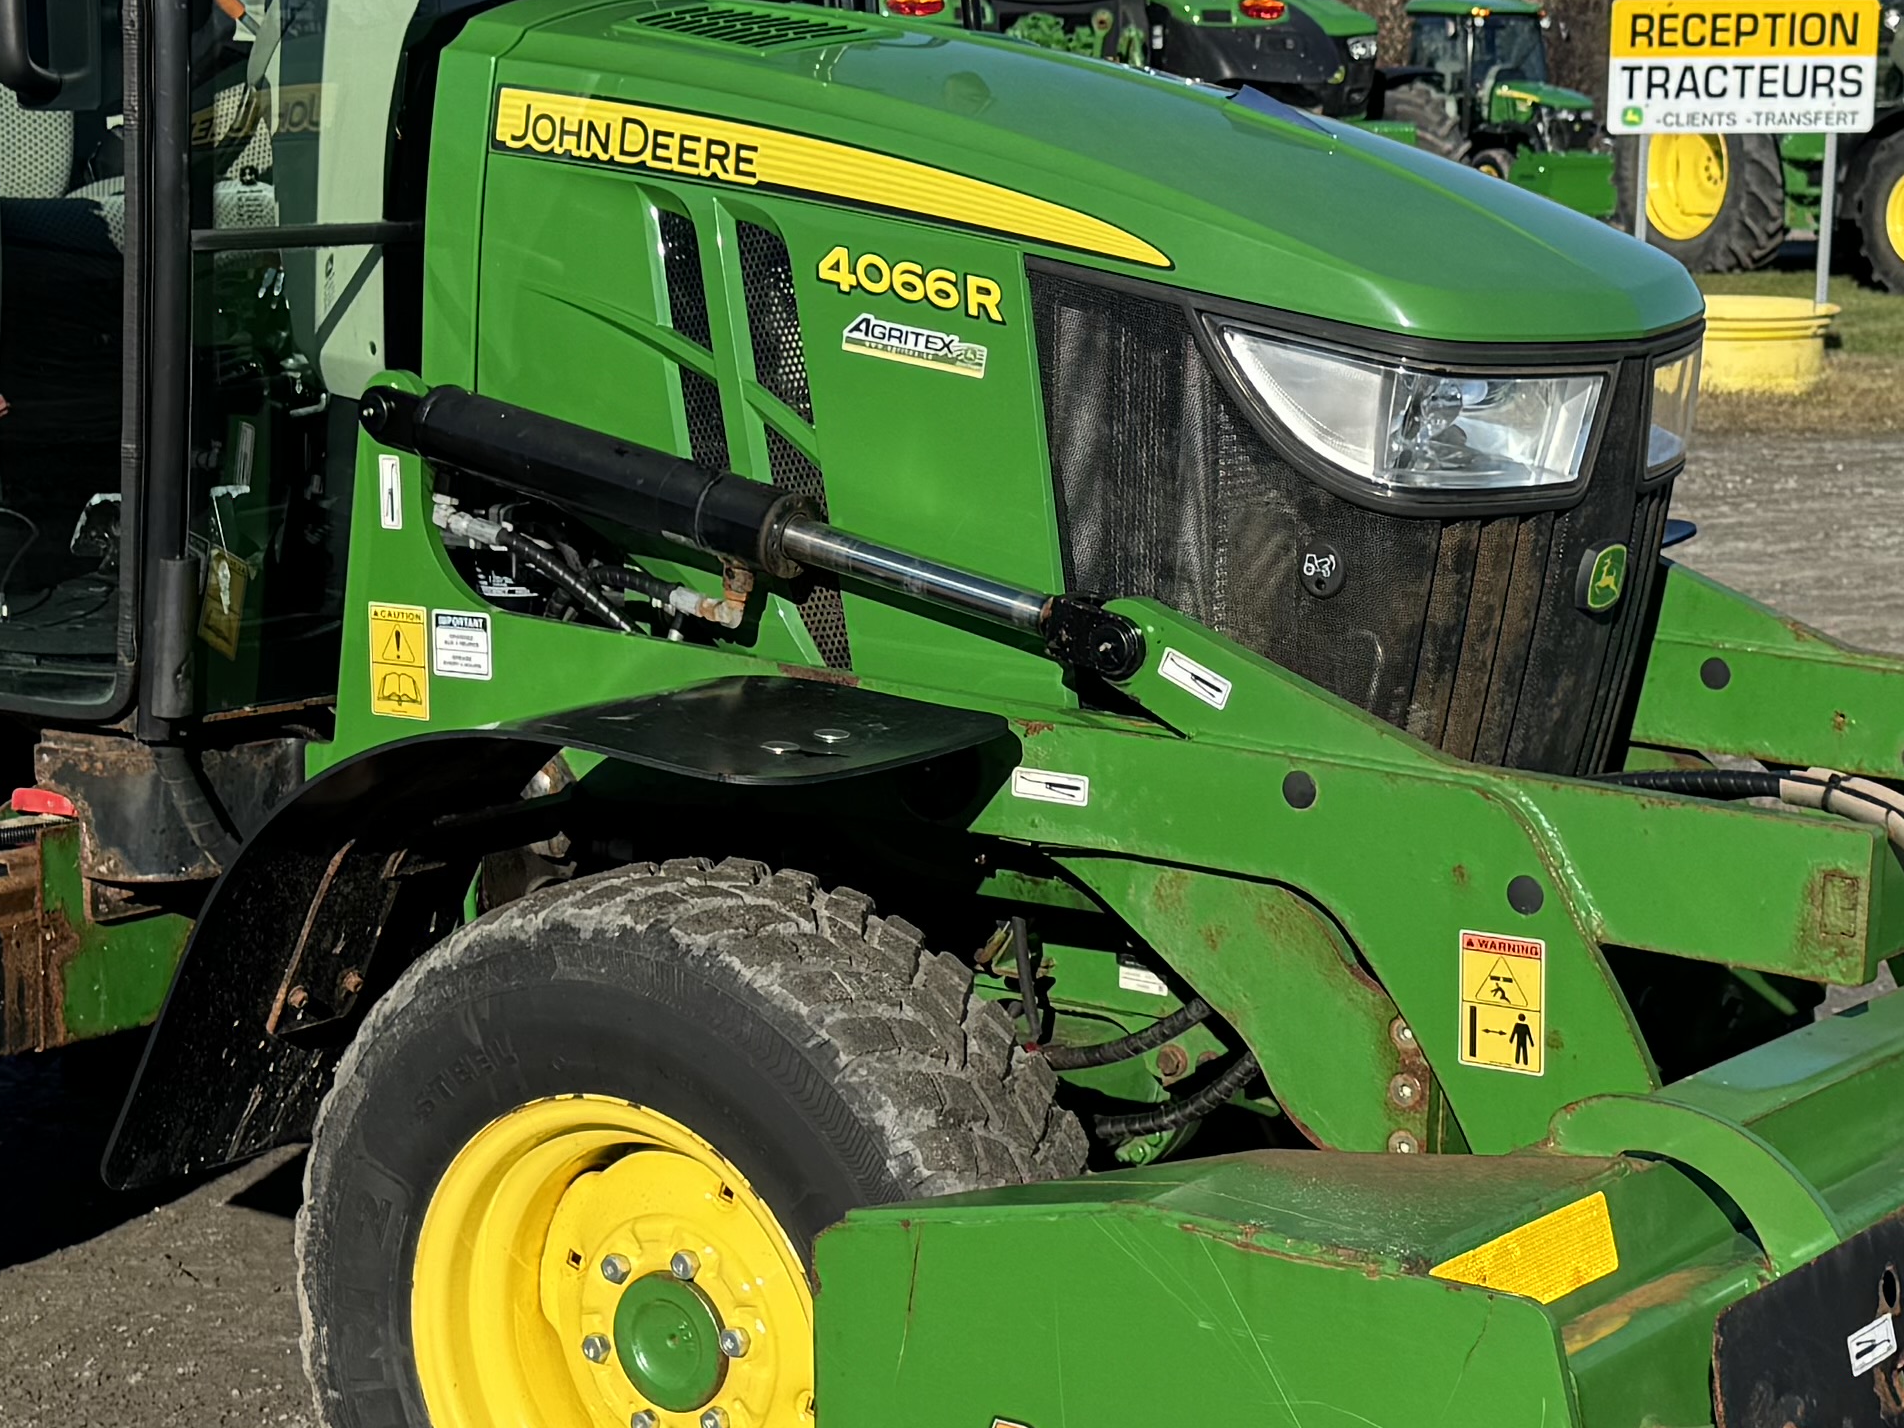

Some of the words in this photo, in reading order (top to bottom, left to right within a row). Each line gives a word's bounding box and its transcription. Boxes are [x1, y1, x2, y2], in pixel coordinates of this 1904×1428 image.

[1621, 64, 1863, 100] TRACTEURS
[510, 103, 612, 155] JOHN
[618, 116, 759, 180] DEERE
[847, 317, 955, 355] AGRITEX
[380, 609, 421, 622] CAUTION
[1477, 938, 1539, 956] WARNING
